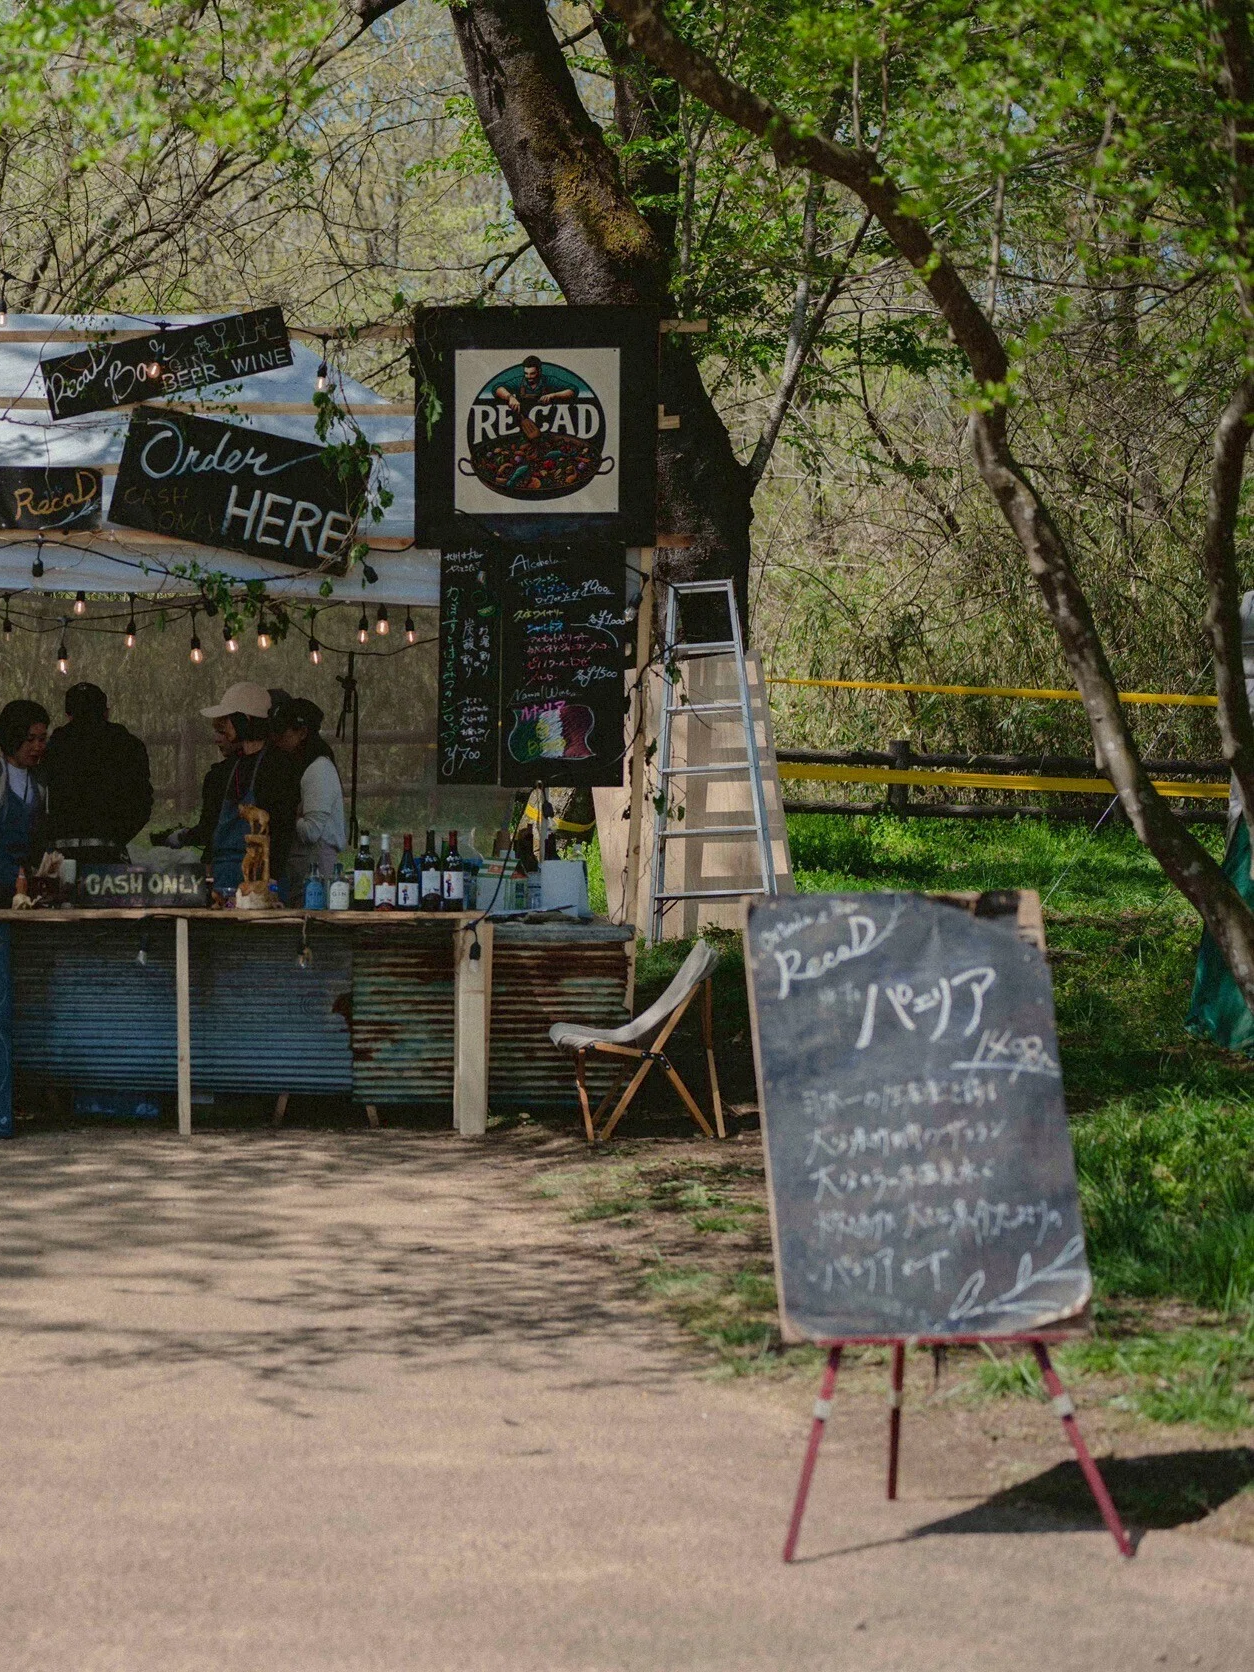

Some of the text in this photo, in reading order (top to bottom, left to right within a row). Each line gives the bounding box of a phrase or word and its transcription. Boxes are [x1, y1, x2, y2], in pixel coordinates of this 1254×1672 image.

[162, 347, 289, 393] BEER WINE
[141, 418, 320, 479] Order
[221, 484, 354, 562] HERE
[86, 873, 203, 896] CASH ONLY
